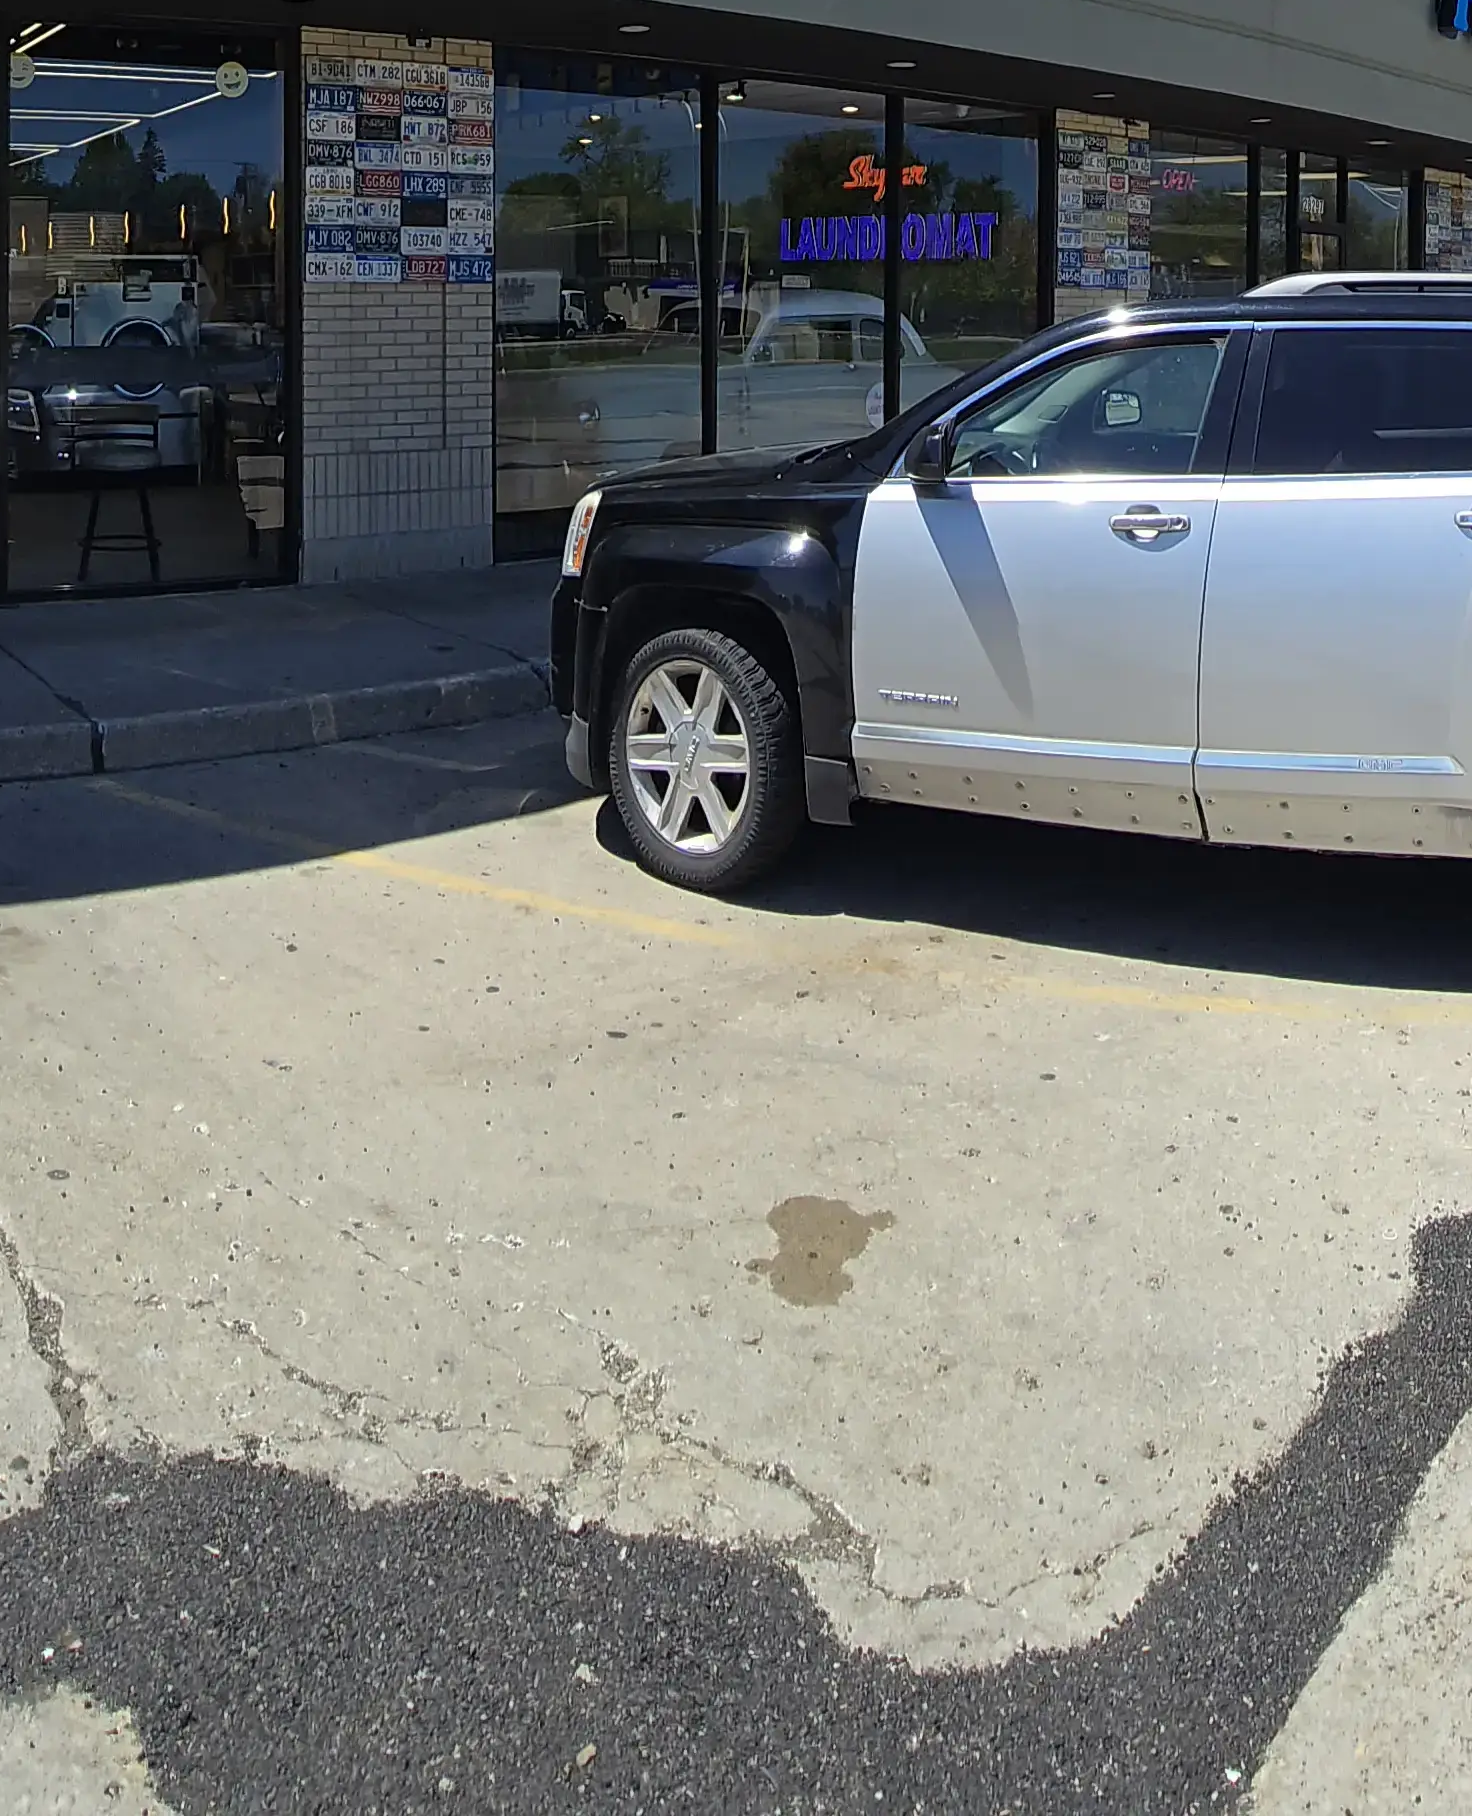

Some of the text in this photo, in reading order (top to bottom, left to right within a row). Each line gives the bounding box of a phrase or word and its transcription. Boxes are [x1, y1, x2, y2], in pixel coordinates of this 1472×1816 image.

[843, 154, 927, 202] Skyar
[1163, 169, 1194, 191] OPEN
[780, 212, 998, 260] LAUNDOMAT
